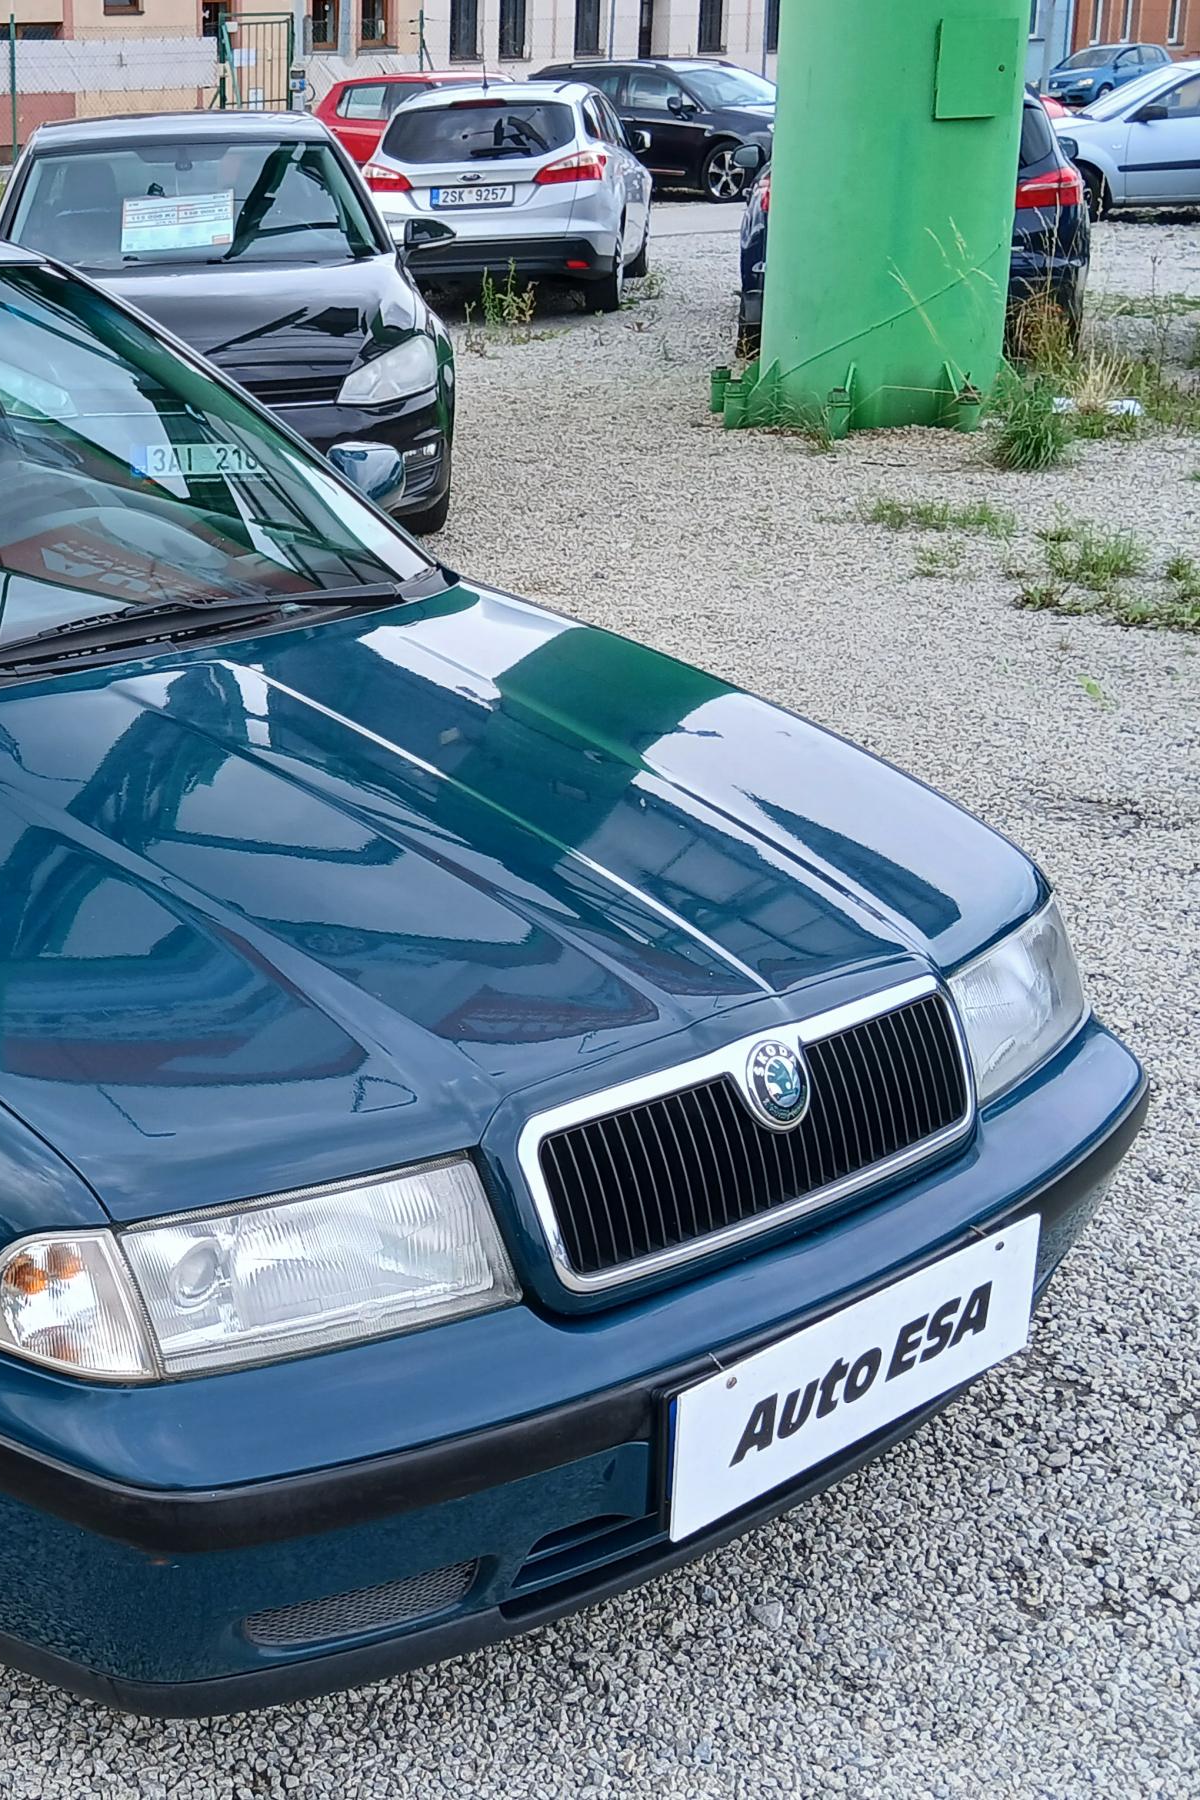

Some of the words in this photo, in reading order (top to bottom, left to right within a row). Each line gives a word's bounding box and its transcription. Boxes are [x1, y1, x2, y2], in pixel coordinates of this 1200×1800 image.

[442, 190, 465, 203] 2SK
[475, 188, 507, 201] 9257
[729, 1347, 882, 1468] Auto
[885, 1280, 993, 1382] ESA
